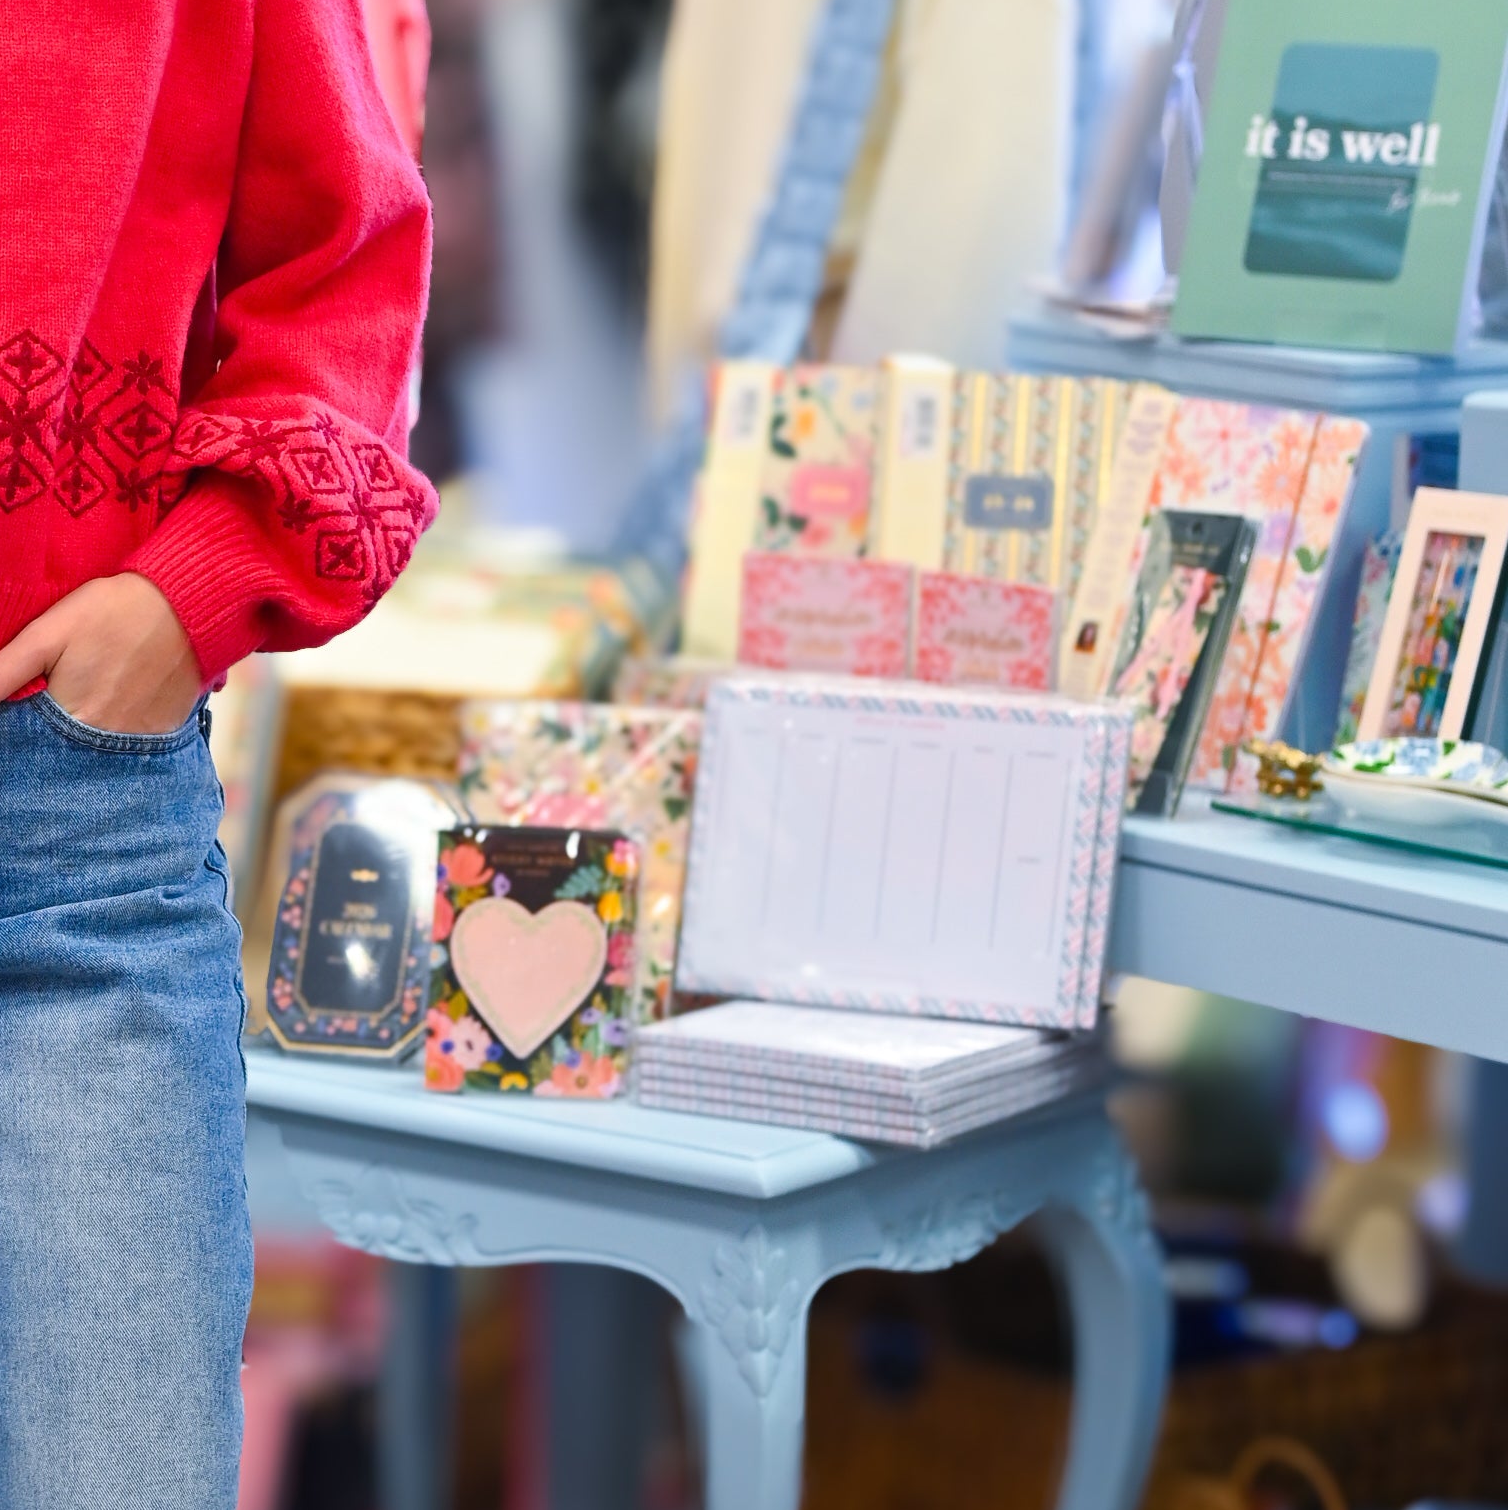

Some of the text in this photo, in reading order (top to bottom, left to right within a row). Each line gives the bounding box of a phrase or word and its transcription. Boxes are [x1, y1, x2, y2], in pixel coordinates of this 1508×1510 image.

[1246, 114, 1441, 167] it is well
